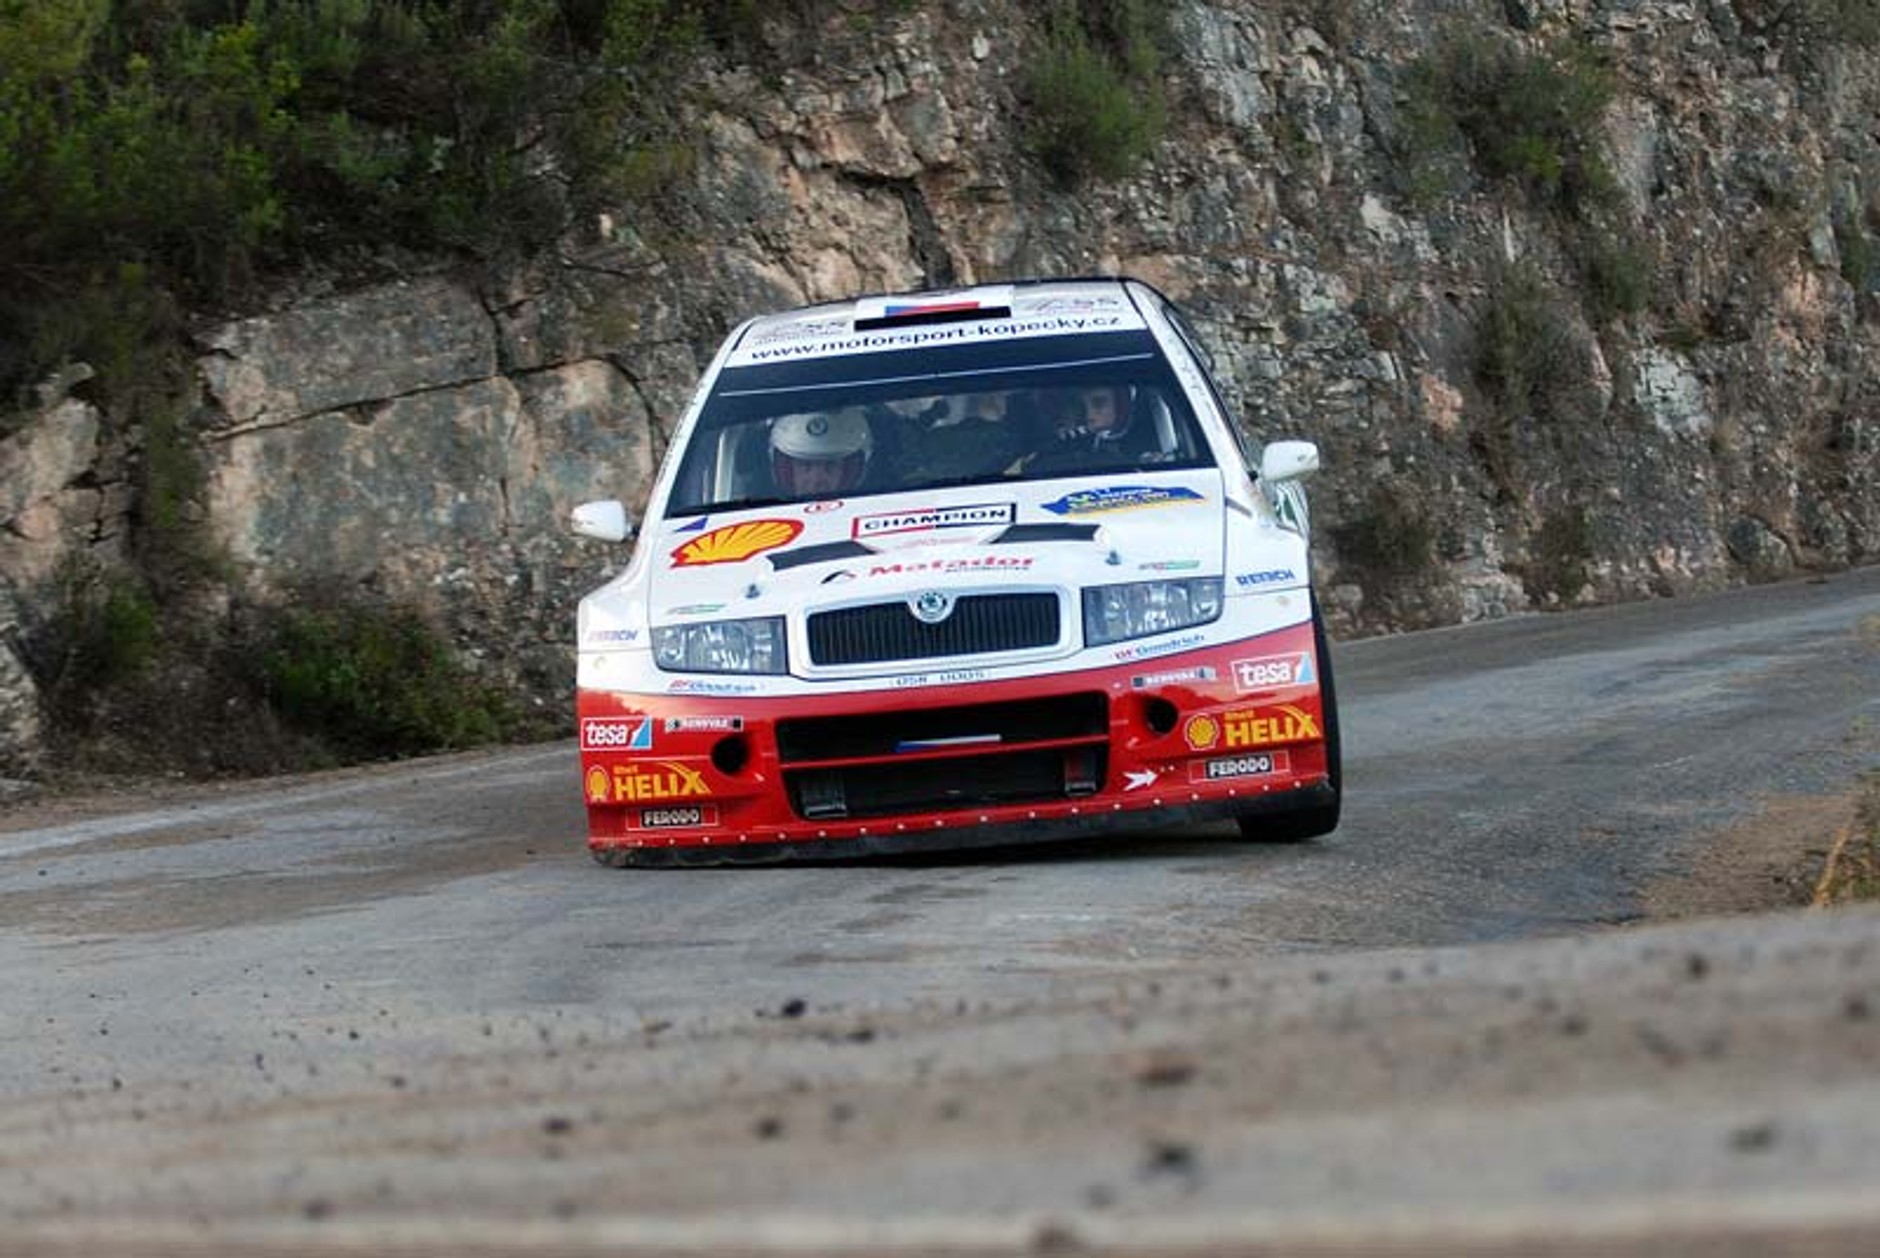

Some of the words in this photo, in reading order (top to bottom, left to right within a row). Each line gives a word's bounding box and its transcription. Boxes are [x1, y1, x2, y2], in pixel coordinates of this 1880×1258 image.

[752, 316, 1120, 359] www.motorsport-kopecky.cz
[864, 509, 1005, 530] CHAMPION
[869, 556, 1034, 576] Matador
[1239, 661, 1291, 686] tesa
[586, 722, 628, 746] tesa
[1224, 711, 1321, 747] HELIX
[1209, 757, 1269, 778] FERODO
[614, 768, 711, 801] HELIX
[644, 809, 699, 826] FERODO
